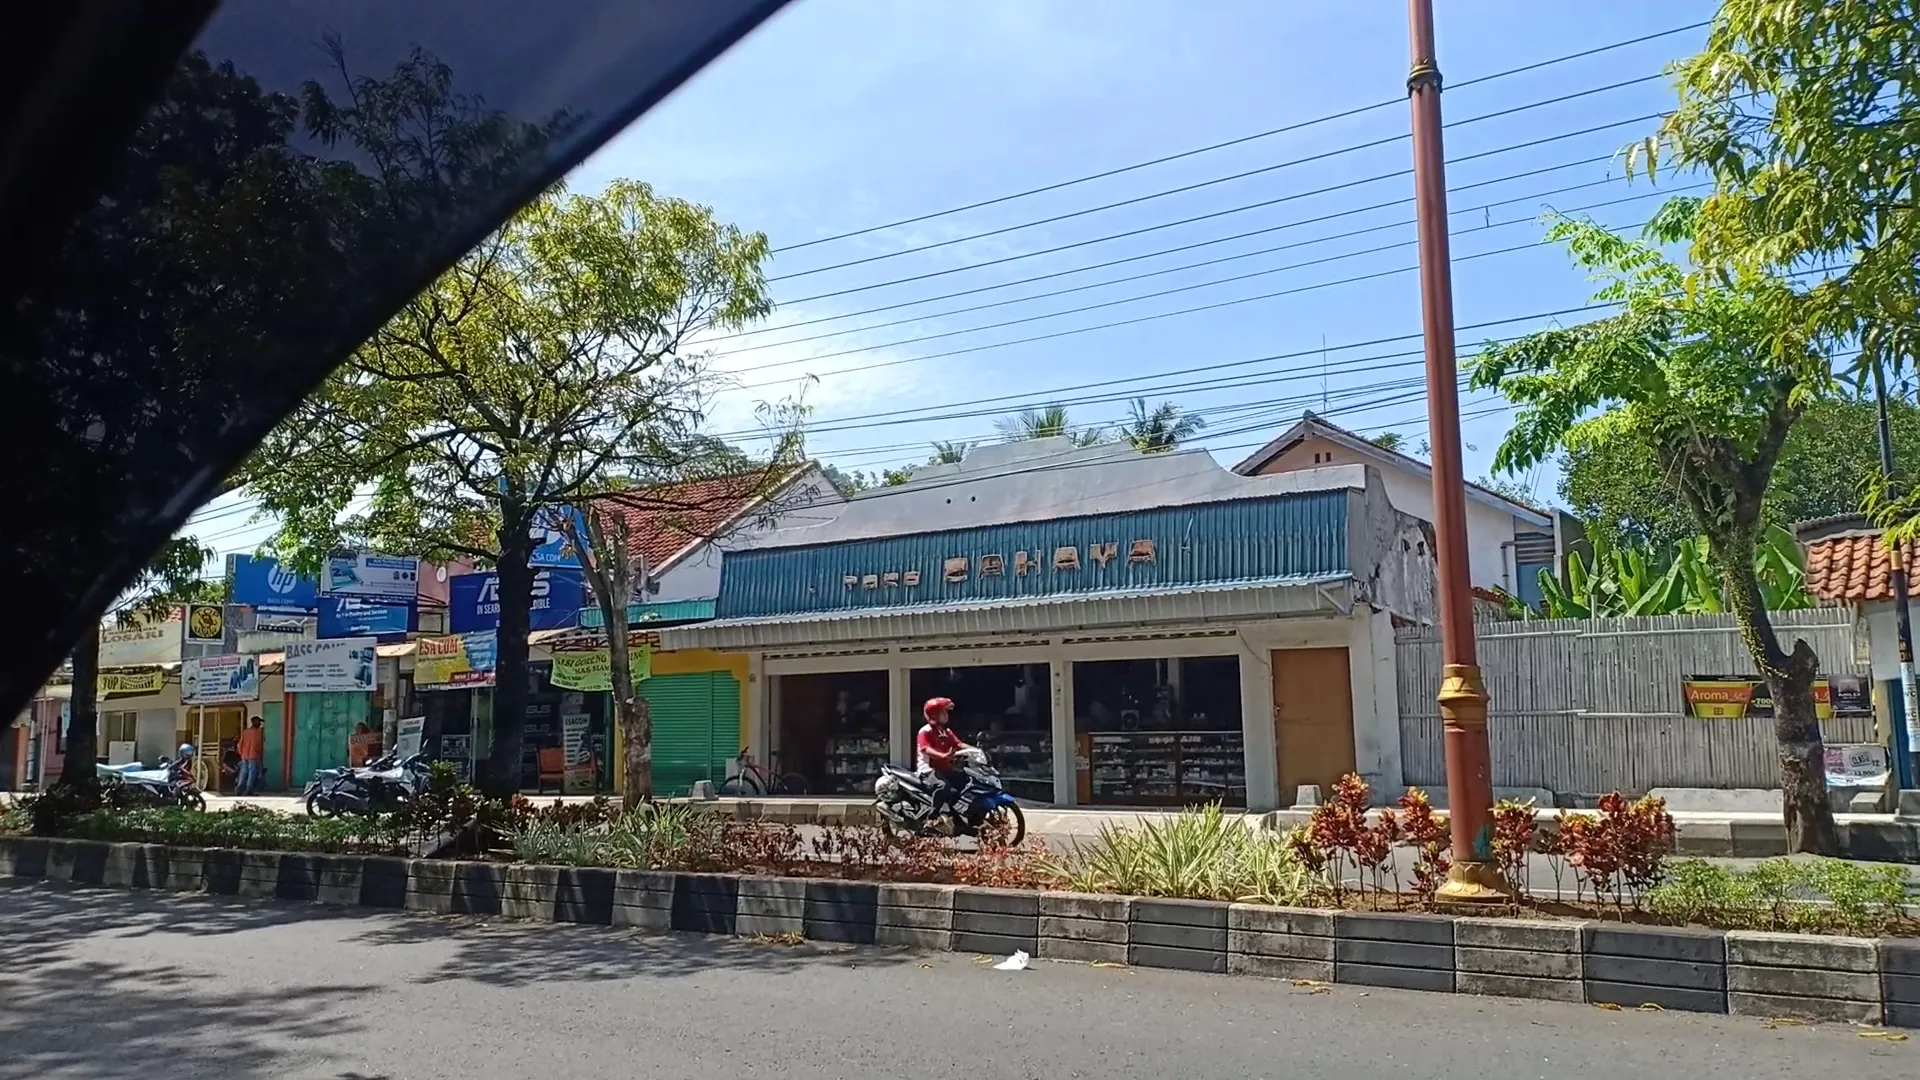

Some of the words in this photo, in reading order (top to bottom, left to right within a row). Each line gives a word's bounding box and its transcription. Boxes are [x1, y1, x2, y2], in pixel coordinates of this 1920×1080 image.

[943, 539, 1156, 583] CAHAYA
[271, 563, 294, 593] hp
[477, 603, 484, 615] IN
[575, 653, 608, 666] GORENG
[1690, 690, 1729, 700] Aroma
